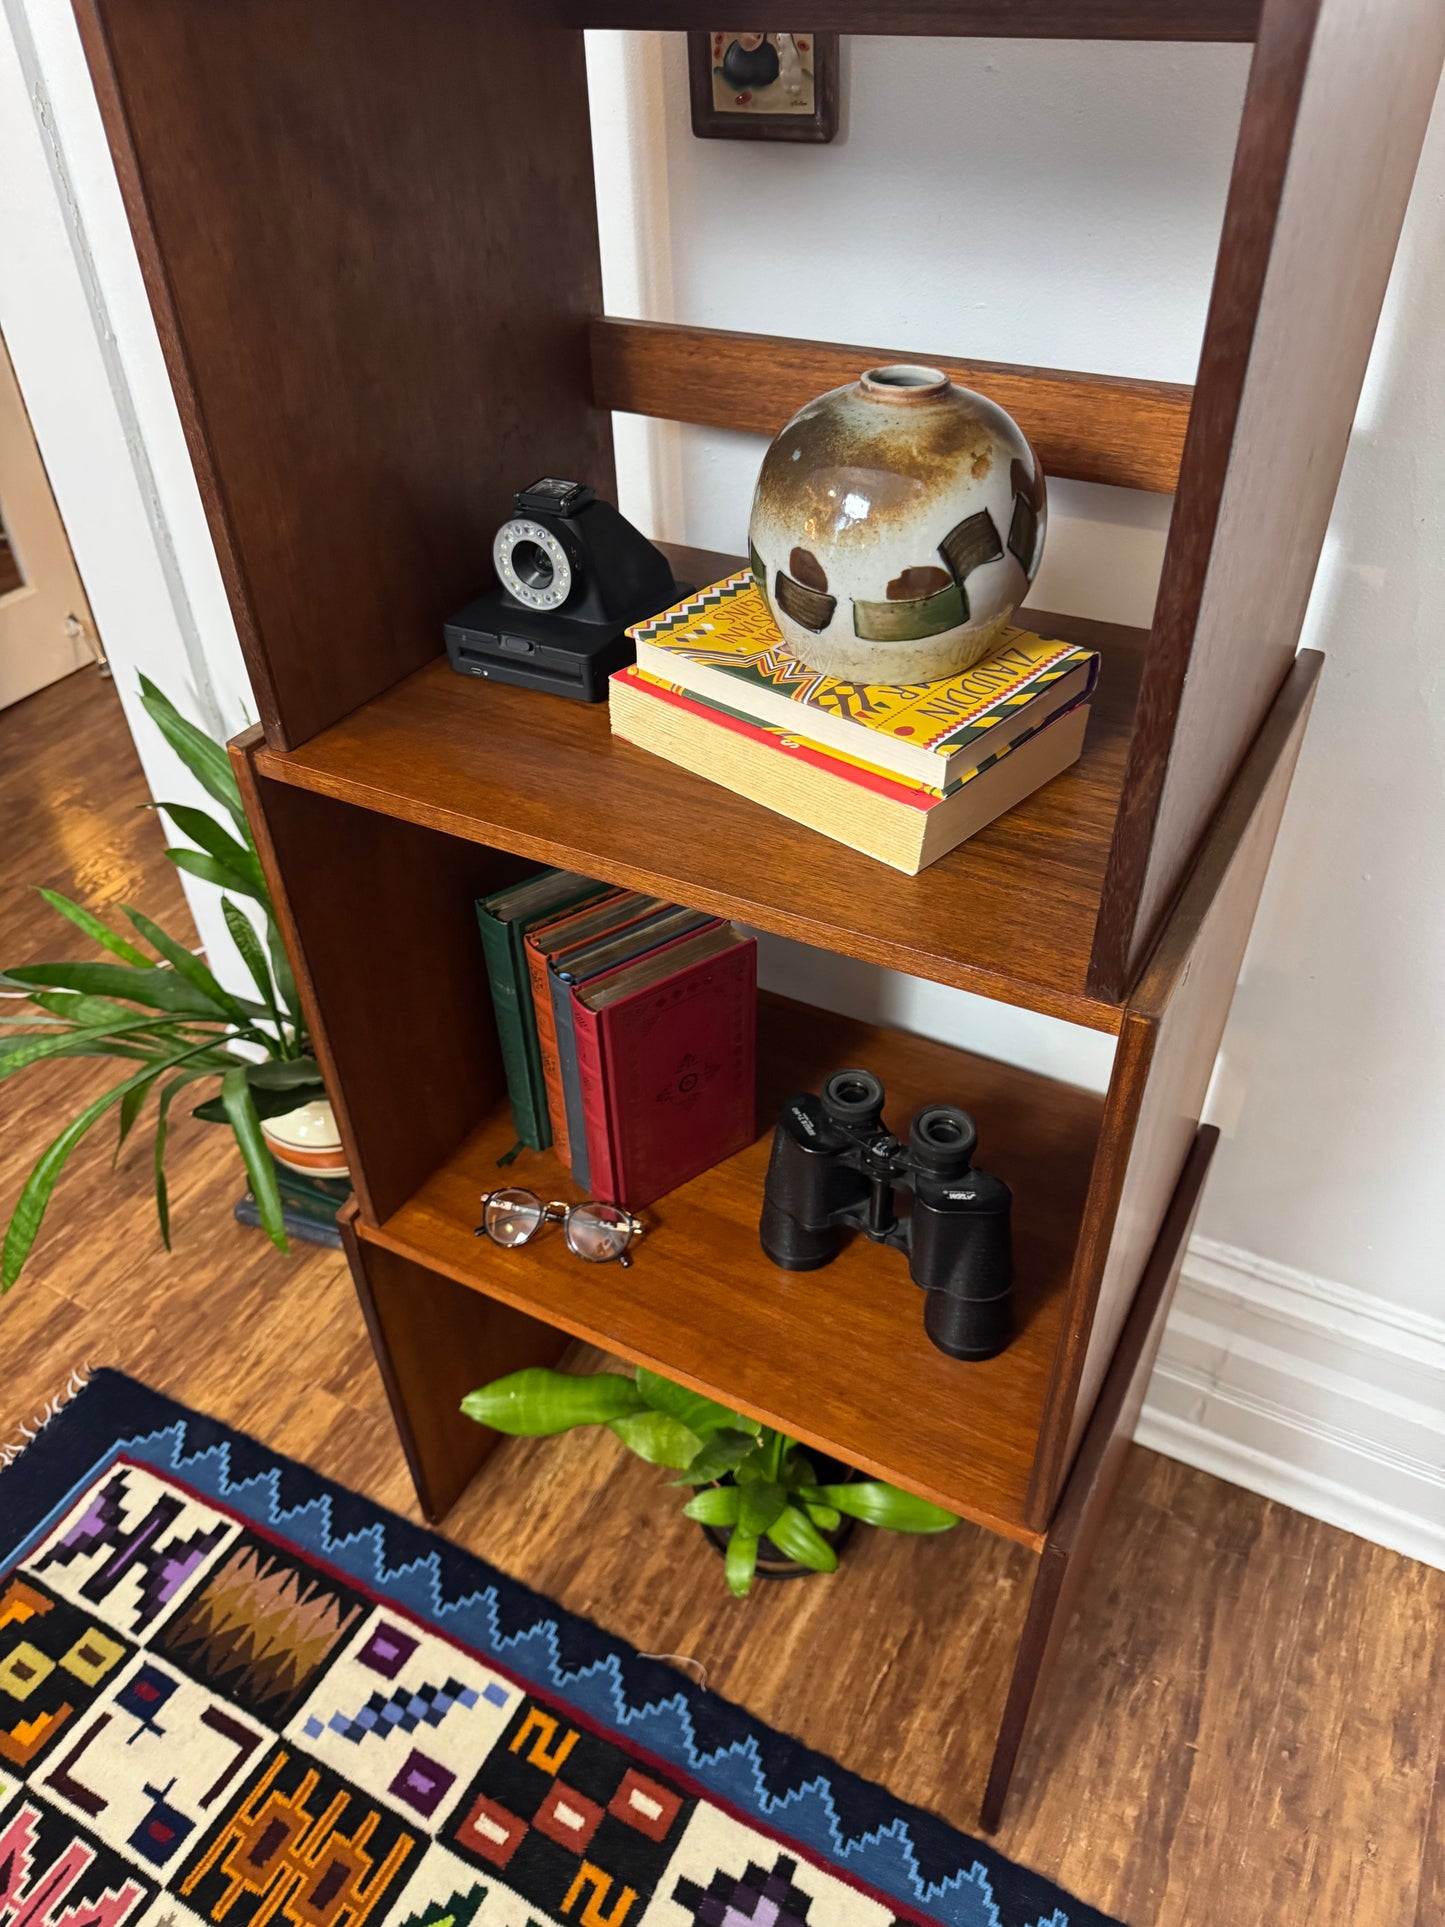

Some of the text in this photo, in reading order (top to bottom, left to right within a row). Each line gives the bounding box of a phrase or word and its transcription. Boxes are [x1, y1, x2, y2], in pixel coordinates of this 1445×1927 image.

[713, 596, 764, 624] GINS
[714, 612, 774, 644] STANI
[915, 647, 1043, 723] ZIAUDDIN
